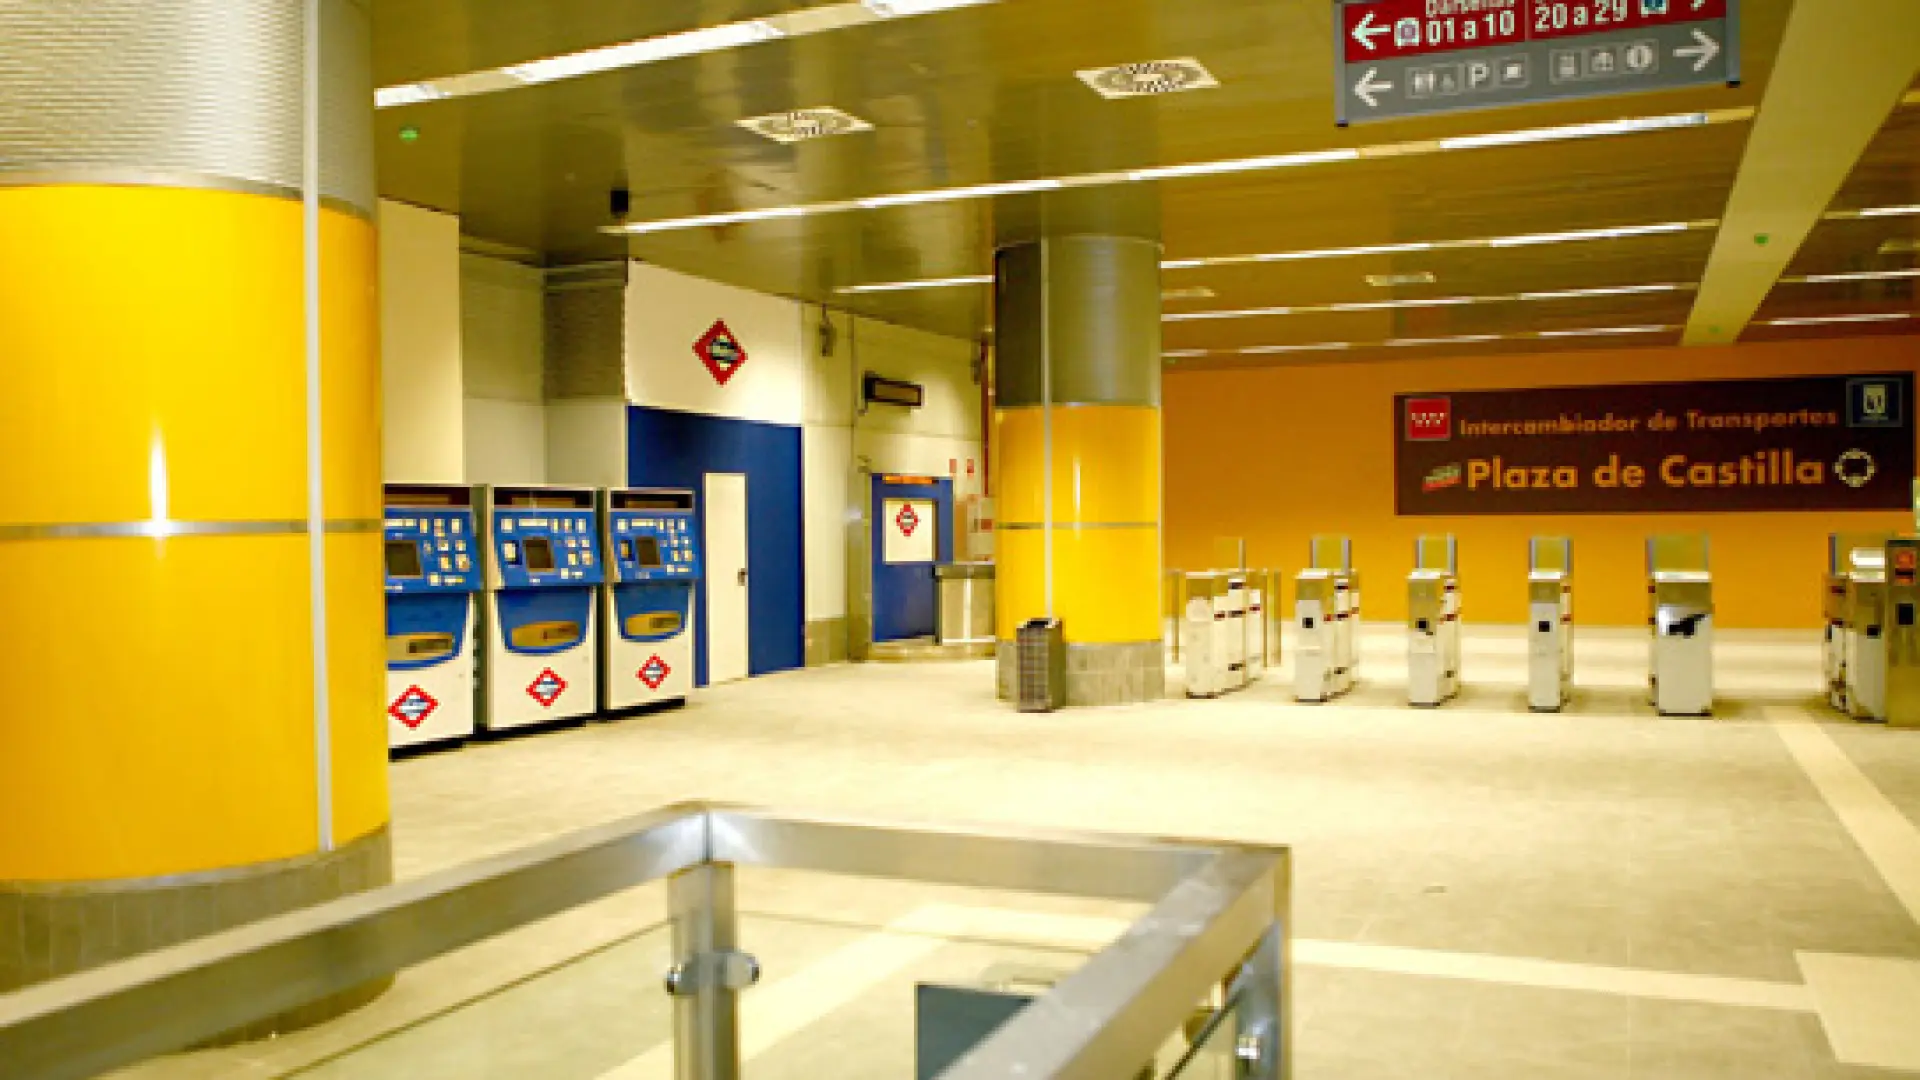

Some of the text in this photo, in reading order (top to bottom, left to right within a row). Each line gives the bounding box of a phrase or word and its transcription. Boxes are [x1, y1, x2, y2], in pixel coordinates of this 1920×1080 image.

[1426, 10, 1515, 46] 01 a 10
[1534, 2, 1568, 32] 20
[1573, 6, 1589, 26] a
[1460, 408, 1837, 436] Intercambiador de Transportes
[1467, 455, 1579, 491] Plaza
[1592, 452, 1646, 489] de
[1659, 448, 1825, 488] Castilla
